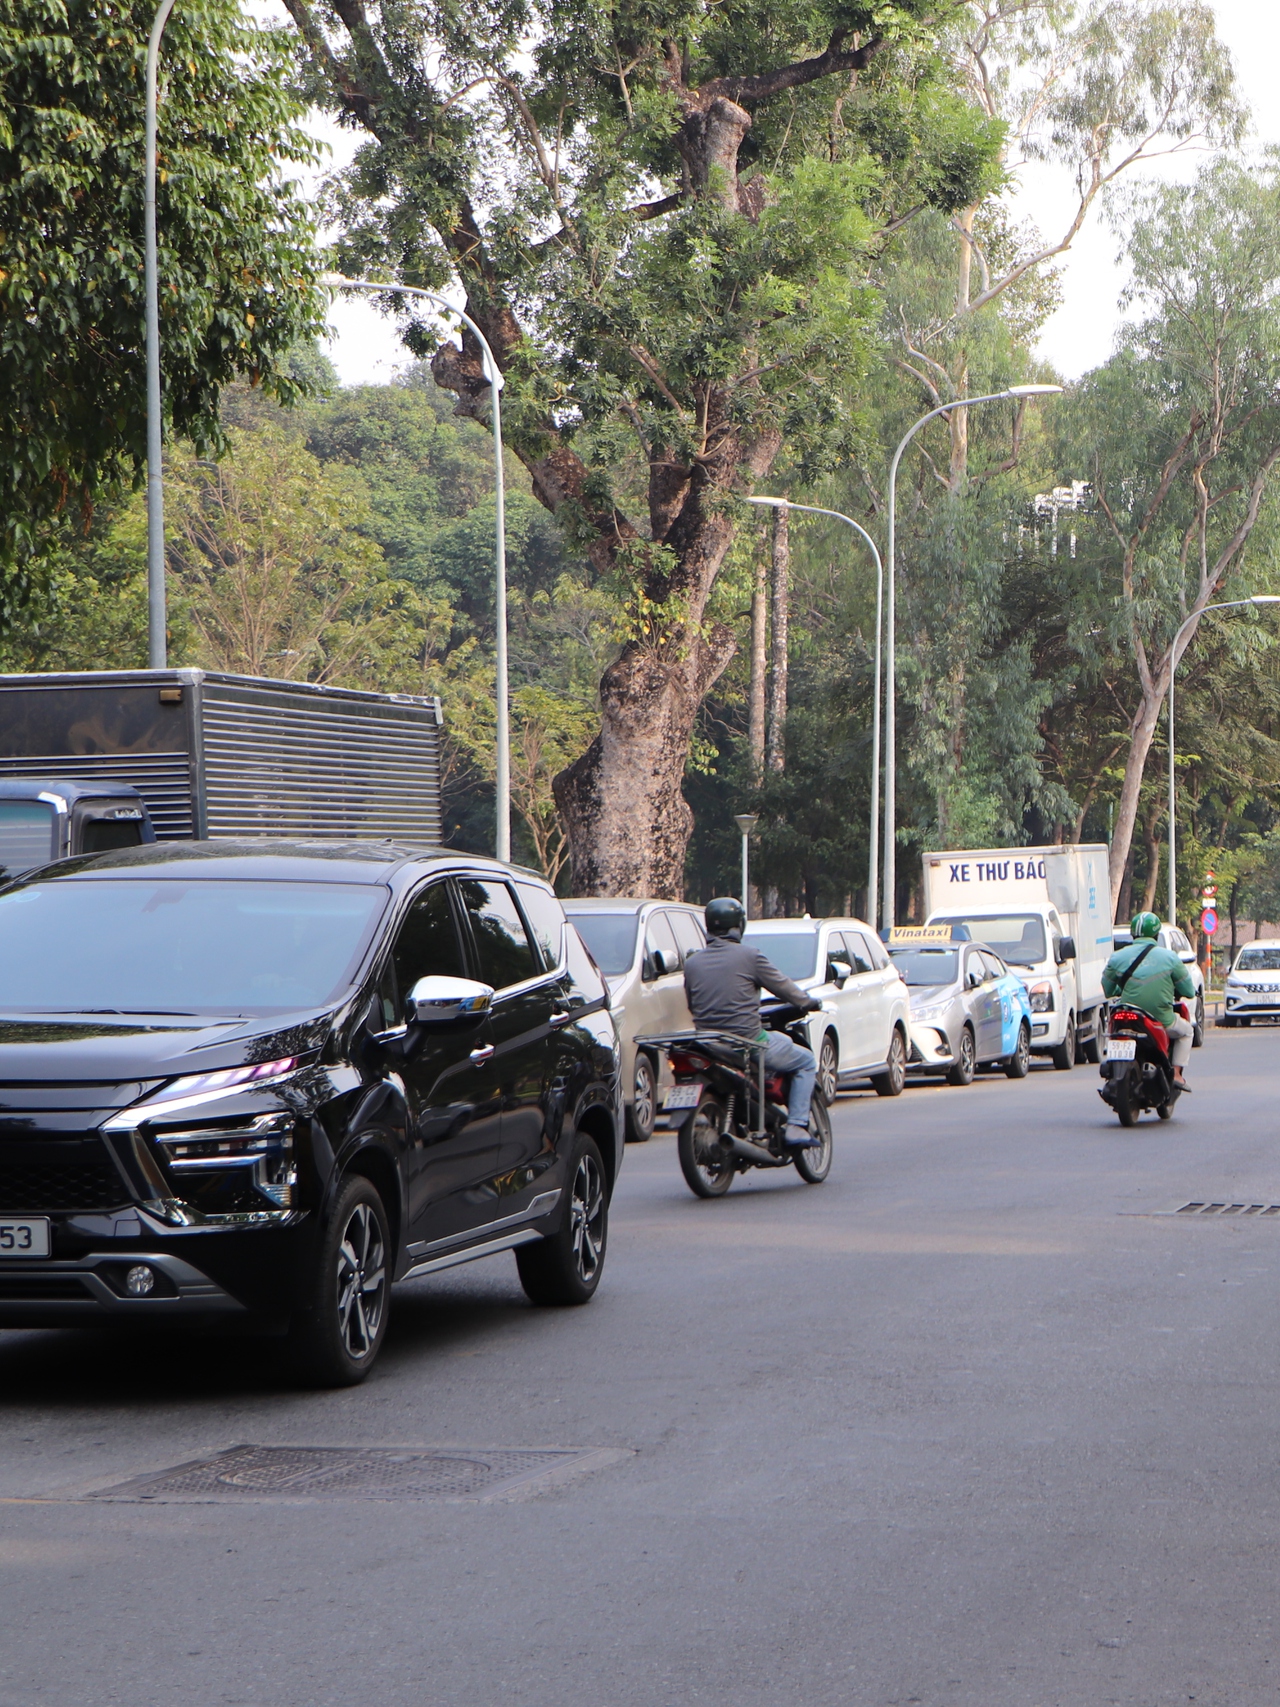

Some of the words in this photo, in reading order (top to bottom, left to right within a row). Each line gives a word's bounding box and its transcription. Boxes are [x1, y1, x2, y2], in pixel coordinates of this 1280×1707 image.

[950, 864, 970, 882] XE
[976, 860, 1010, 881] THƯ
[894, 927, 949, 938] Vinataxi
[0, 1225, 32, 1249] 53
